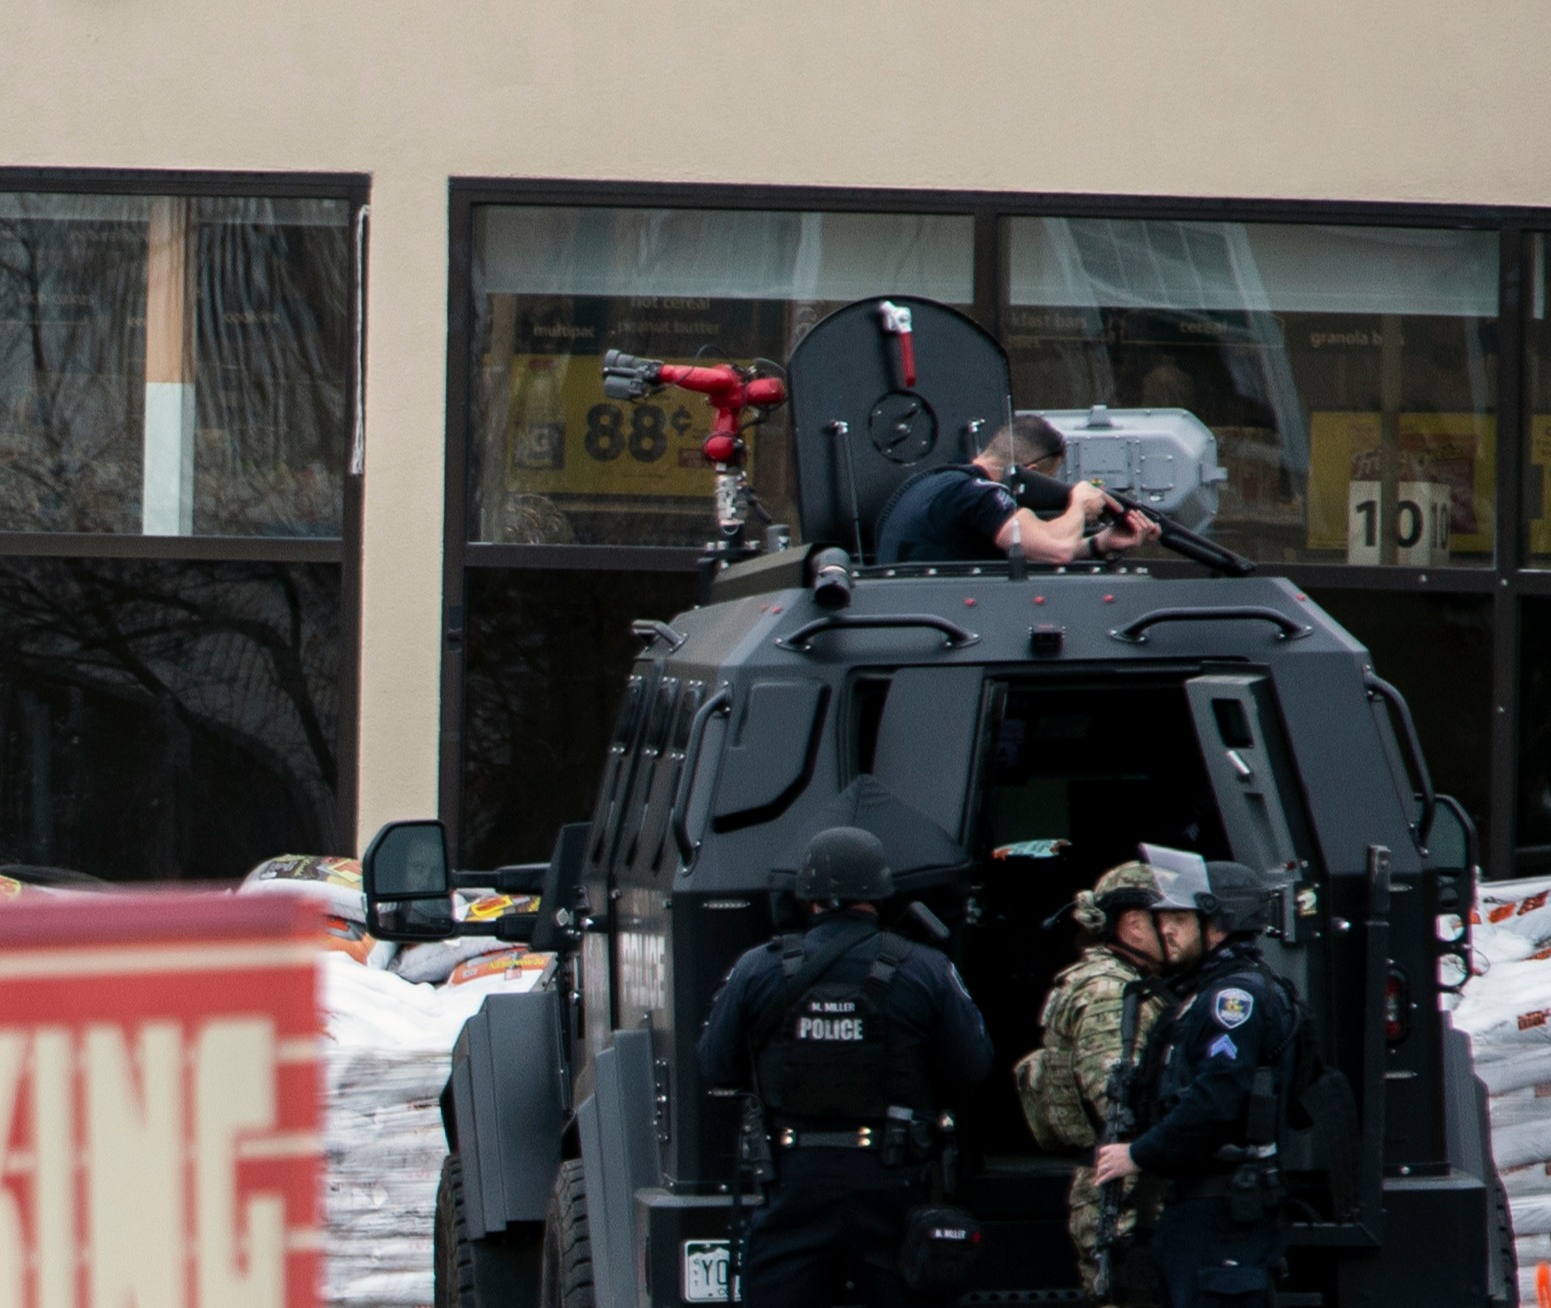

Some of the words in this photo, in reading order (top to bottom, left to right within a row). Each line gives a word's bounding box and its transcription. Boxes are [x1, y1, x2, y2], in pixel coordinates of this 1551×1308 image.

[532, 325, 595, 340] multipac
[673, 321, 721, 335] butter
[1309, 330, 1369, 349] granola
[1356, 499, 1423, 549] 10
[824, 1001, 856, 1013] MILLER
[799, 1016, 864, 1041] POLICE
